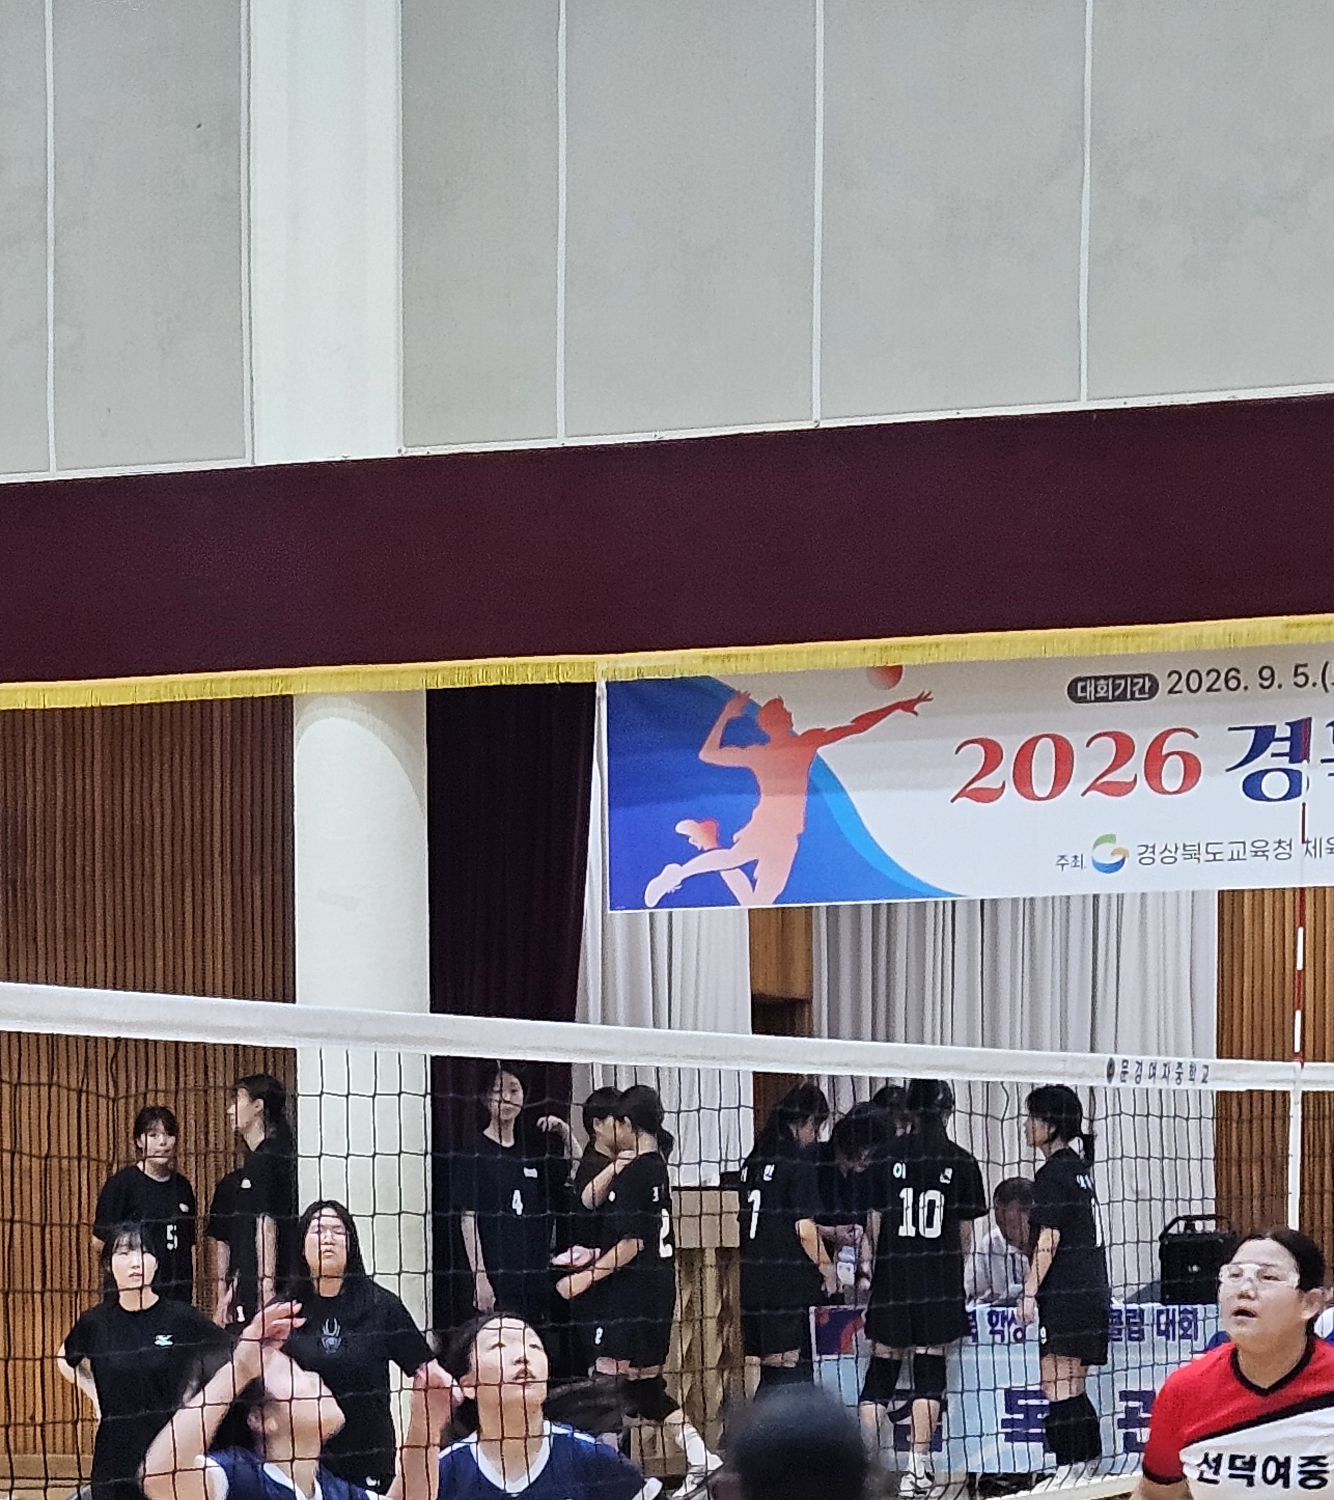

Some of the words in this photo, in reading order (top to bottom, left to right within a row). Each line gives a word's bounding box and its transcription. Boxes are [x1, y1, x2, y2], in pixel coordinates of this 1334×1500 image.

[1077, 678, 1152, 700] 대회기간
[1167, 668, 1248, 695] 2026.
[1258, 665, 1282, 690] 9.
[950, 727, 1204, 804] 2026
[1055, 853, 1085, 871] 주최
[1137, 838, 1294, 867] 경상북도교육청
[897, 1187, 945, 1239] 10
[1195, 1451, 1331, 1491] 선덕여중
